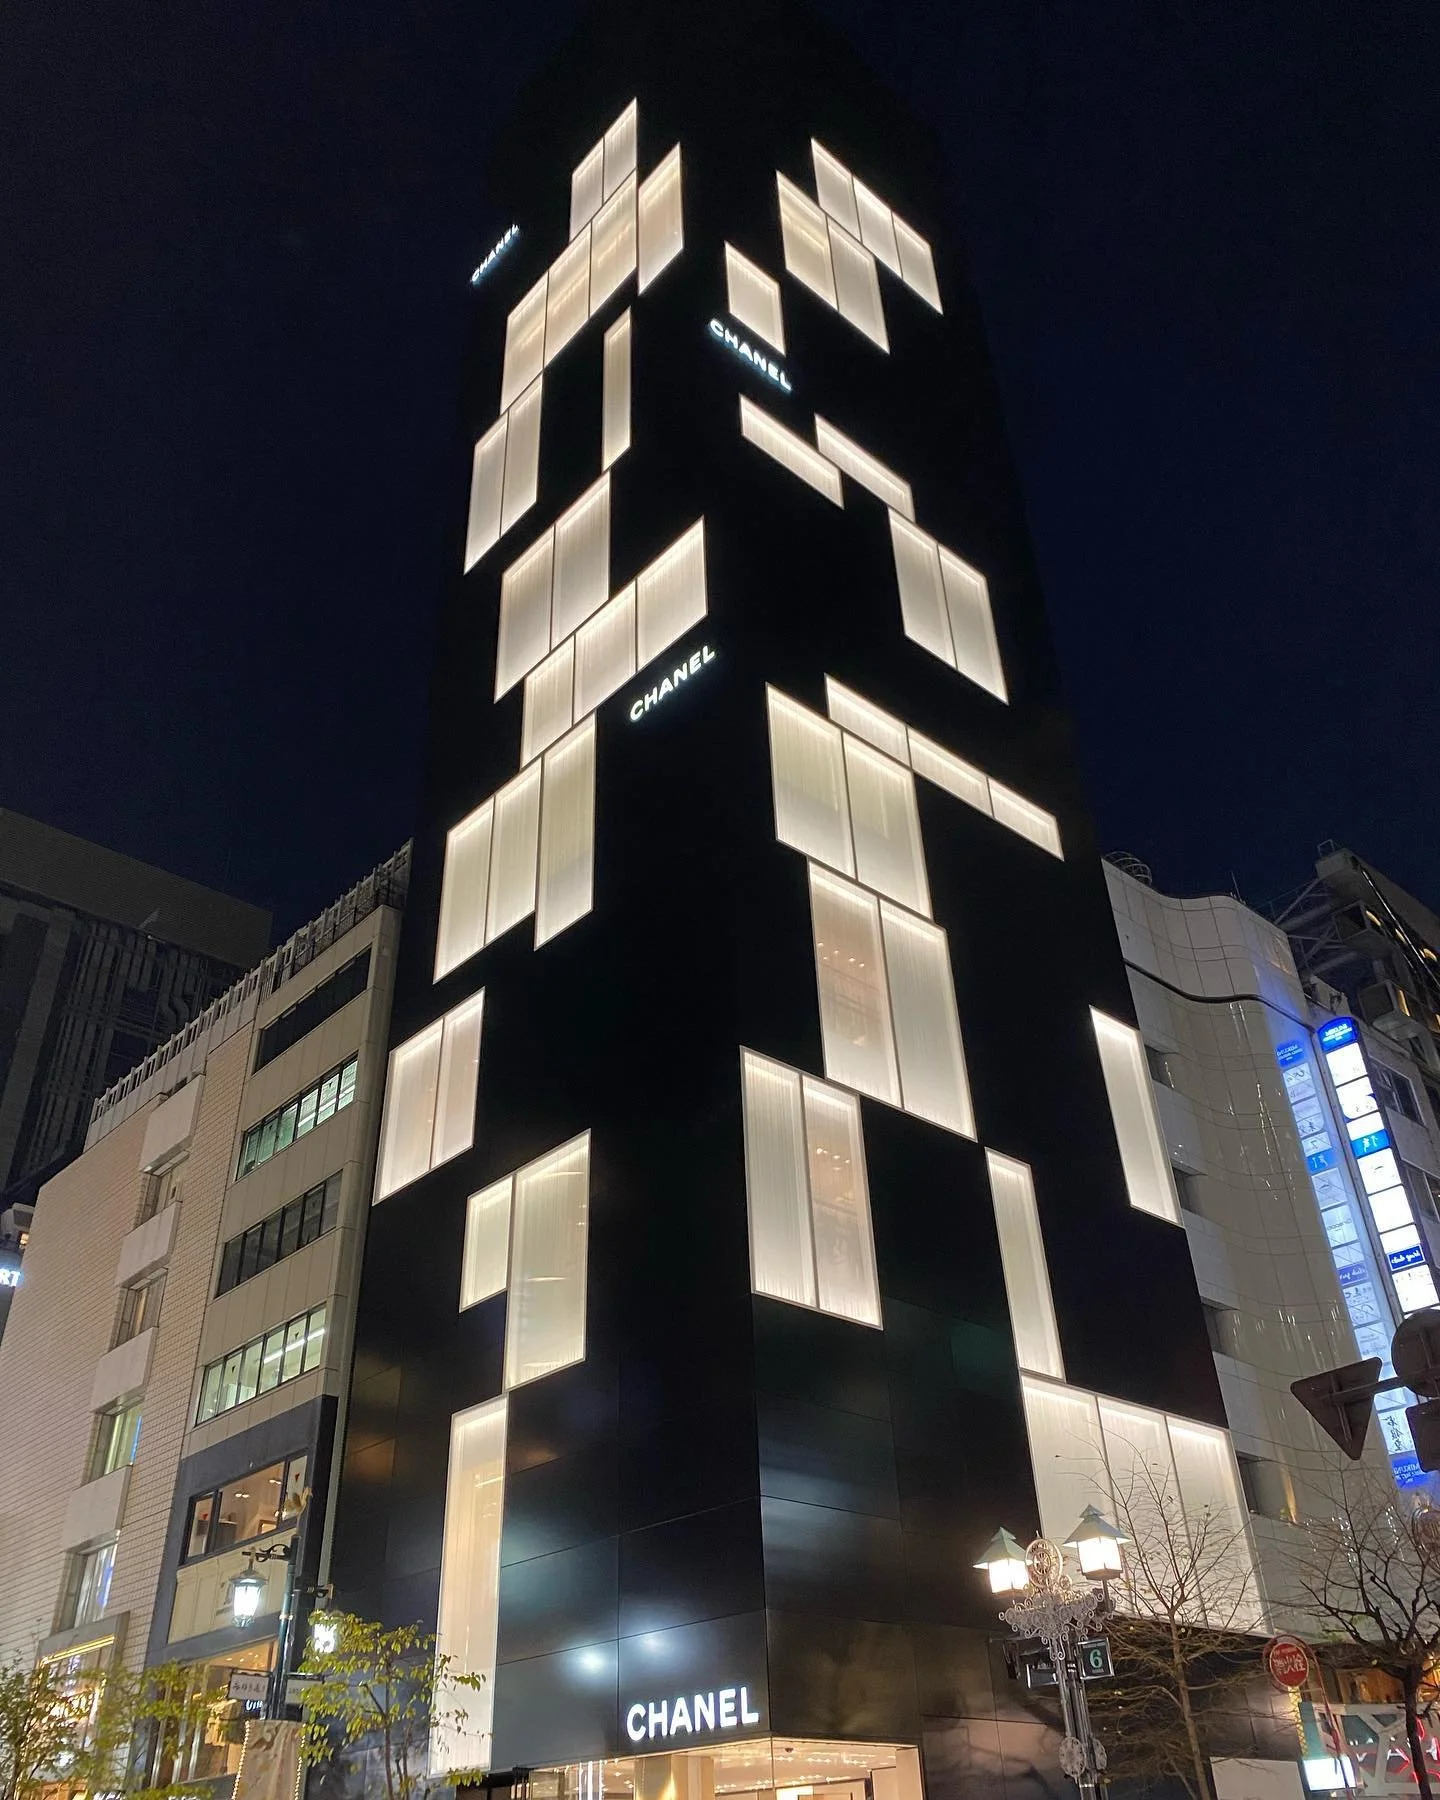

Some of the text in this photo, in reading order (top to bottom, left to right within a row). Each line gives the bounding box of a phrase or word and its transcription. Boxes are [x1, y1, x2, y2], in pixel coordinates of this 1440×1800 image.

[471, 224, 519, 282] CHANEL
[710, 319, 792, 391] CHANEL
[630, 646, 715, 721] CHANEL
[1090, 1649, 1103, 1669] 6
[626, 1686, 760, 1742] CHANEL
